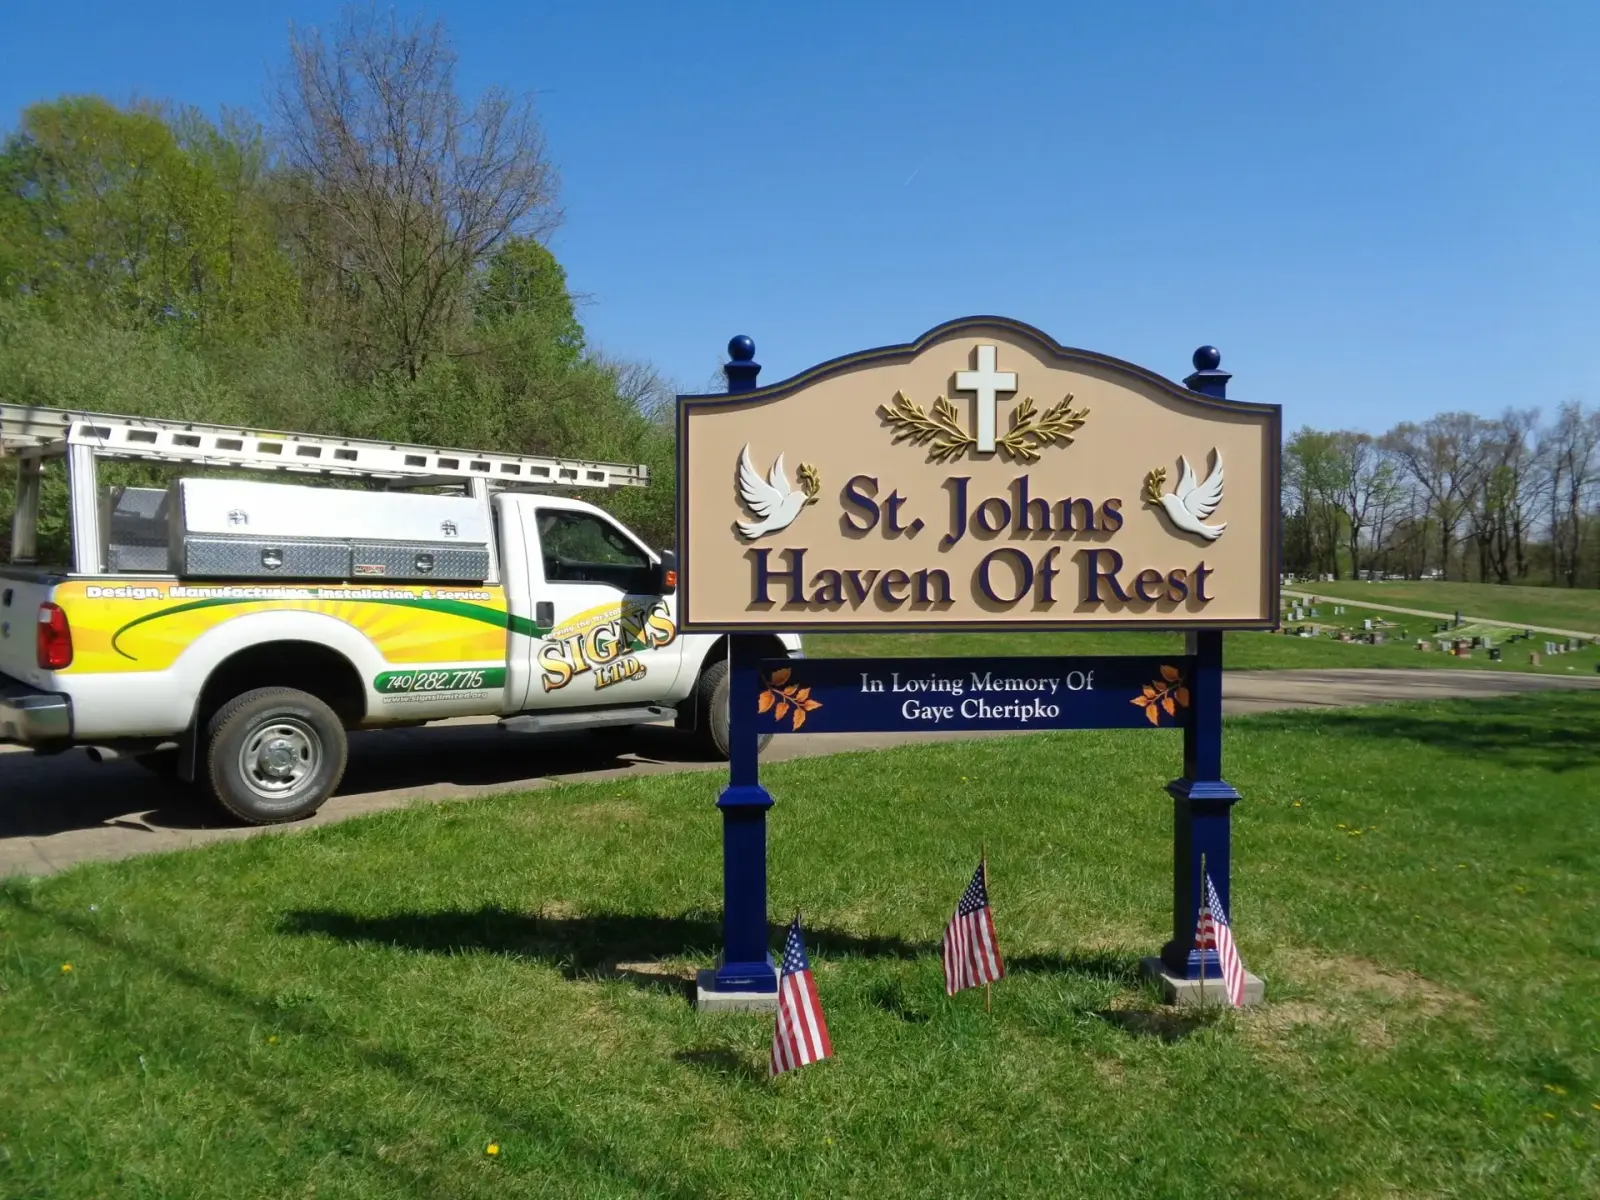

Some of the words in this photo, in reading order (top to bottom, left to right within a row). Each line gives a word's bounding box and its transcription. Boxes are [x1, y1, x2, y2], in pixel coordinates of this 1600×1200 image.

[841, 474, 925, 533] St.
[944, 474, 1123, 544] Johns
[752, 547, 955, 604] Haven
[978, 546, 1061, 603] Of
[1081, 548, 1215, 603] Rest
[86, 586, 164, 600] Design,
[421, 590, 433, 600] &
[437, 590, 490, 601] Service
[537, 599, 677, 693] SIGNS
[594, 656, 647, 690] LTD.
[860, 673, 884, 692] In
[891, 673, 963, 696] Loving
[969, 672, 1060, 695] Memory
[1066, 671, 1094, 691] Of
[383, 692, 488, 704] www.signslimited.org
[902, 699, 953, 722] Gaye
[960, 698, 1060, 722] Cheripko
